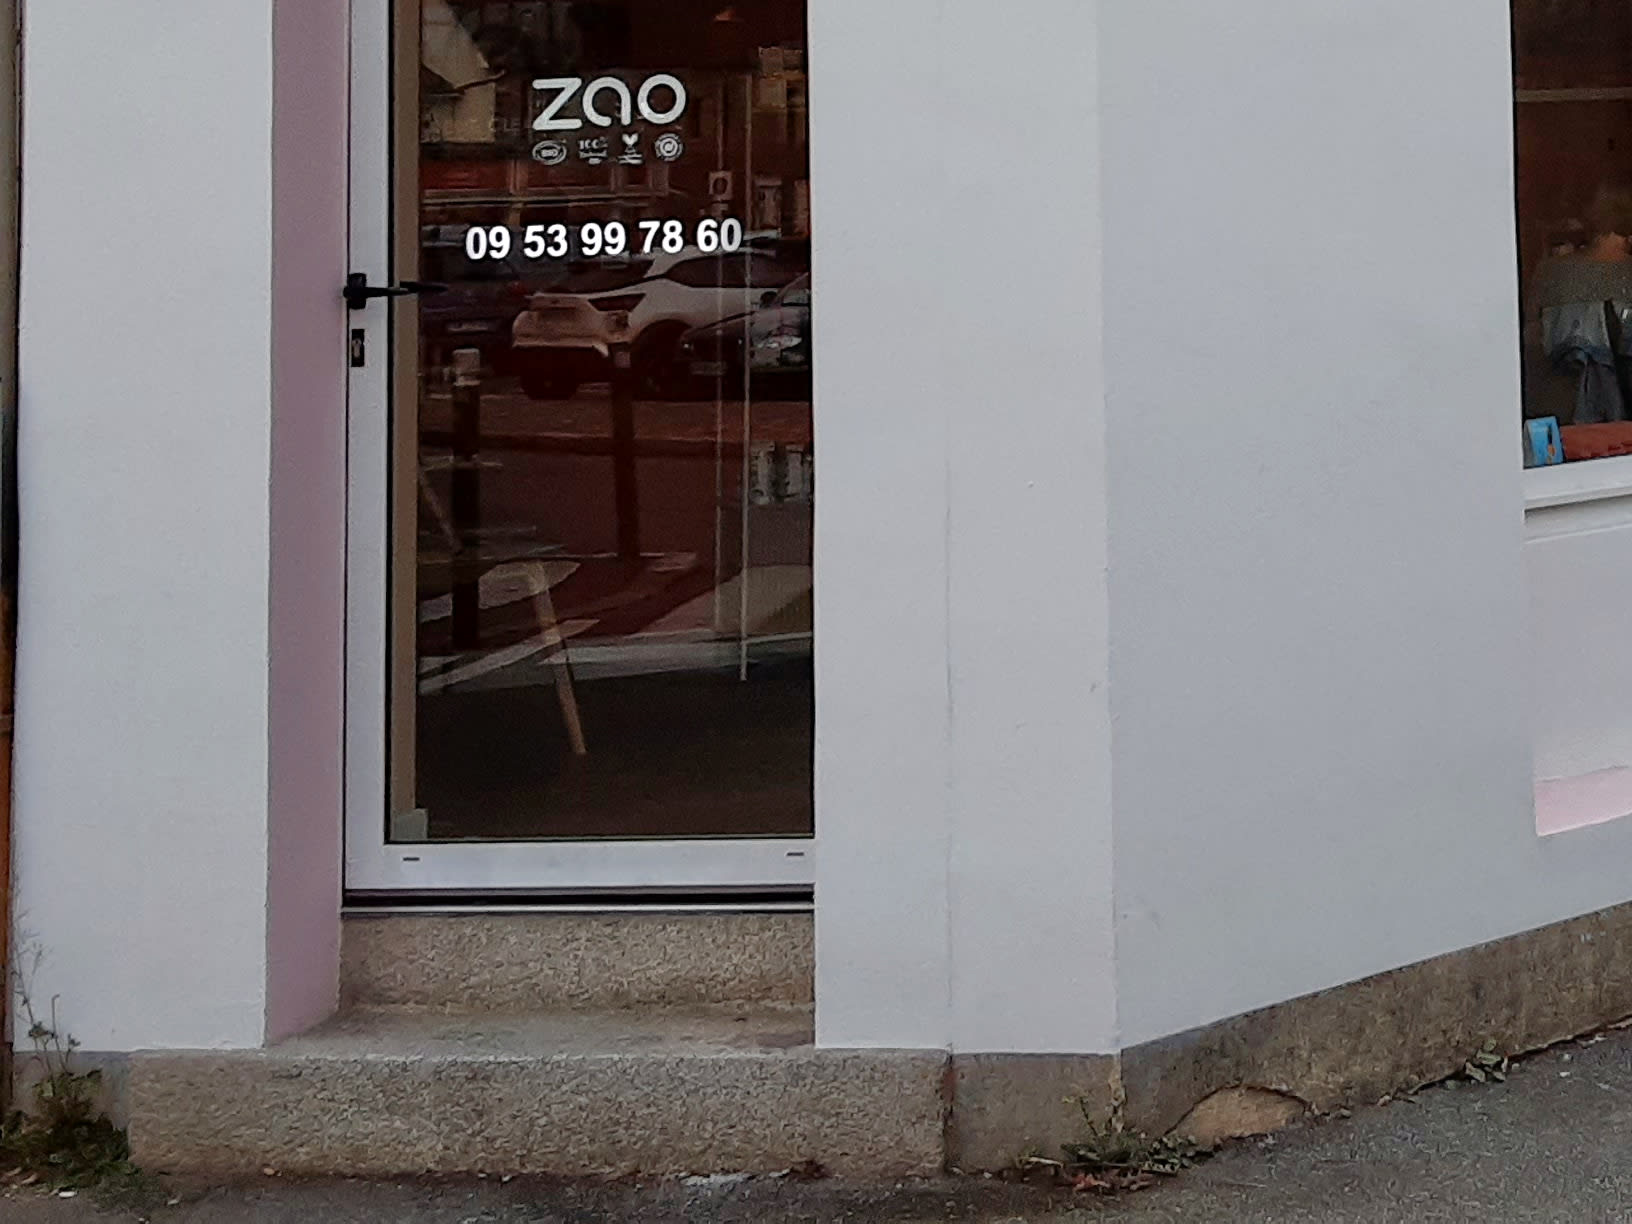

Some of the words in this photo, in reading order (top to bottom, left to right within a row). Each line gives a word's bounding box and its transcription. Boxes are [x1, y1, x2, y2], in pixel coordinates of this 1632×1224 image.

[466, 225, 510, 259] 09
[524, 223, 567, 257] 53
[581, 221, 625, 255] 99
[639, 220, 683, 253] 78
[697, 218, 740, 251] 60
